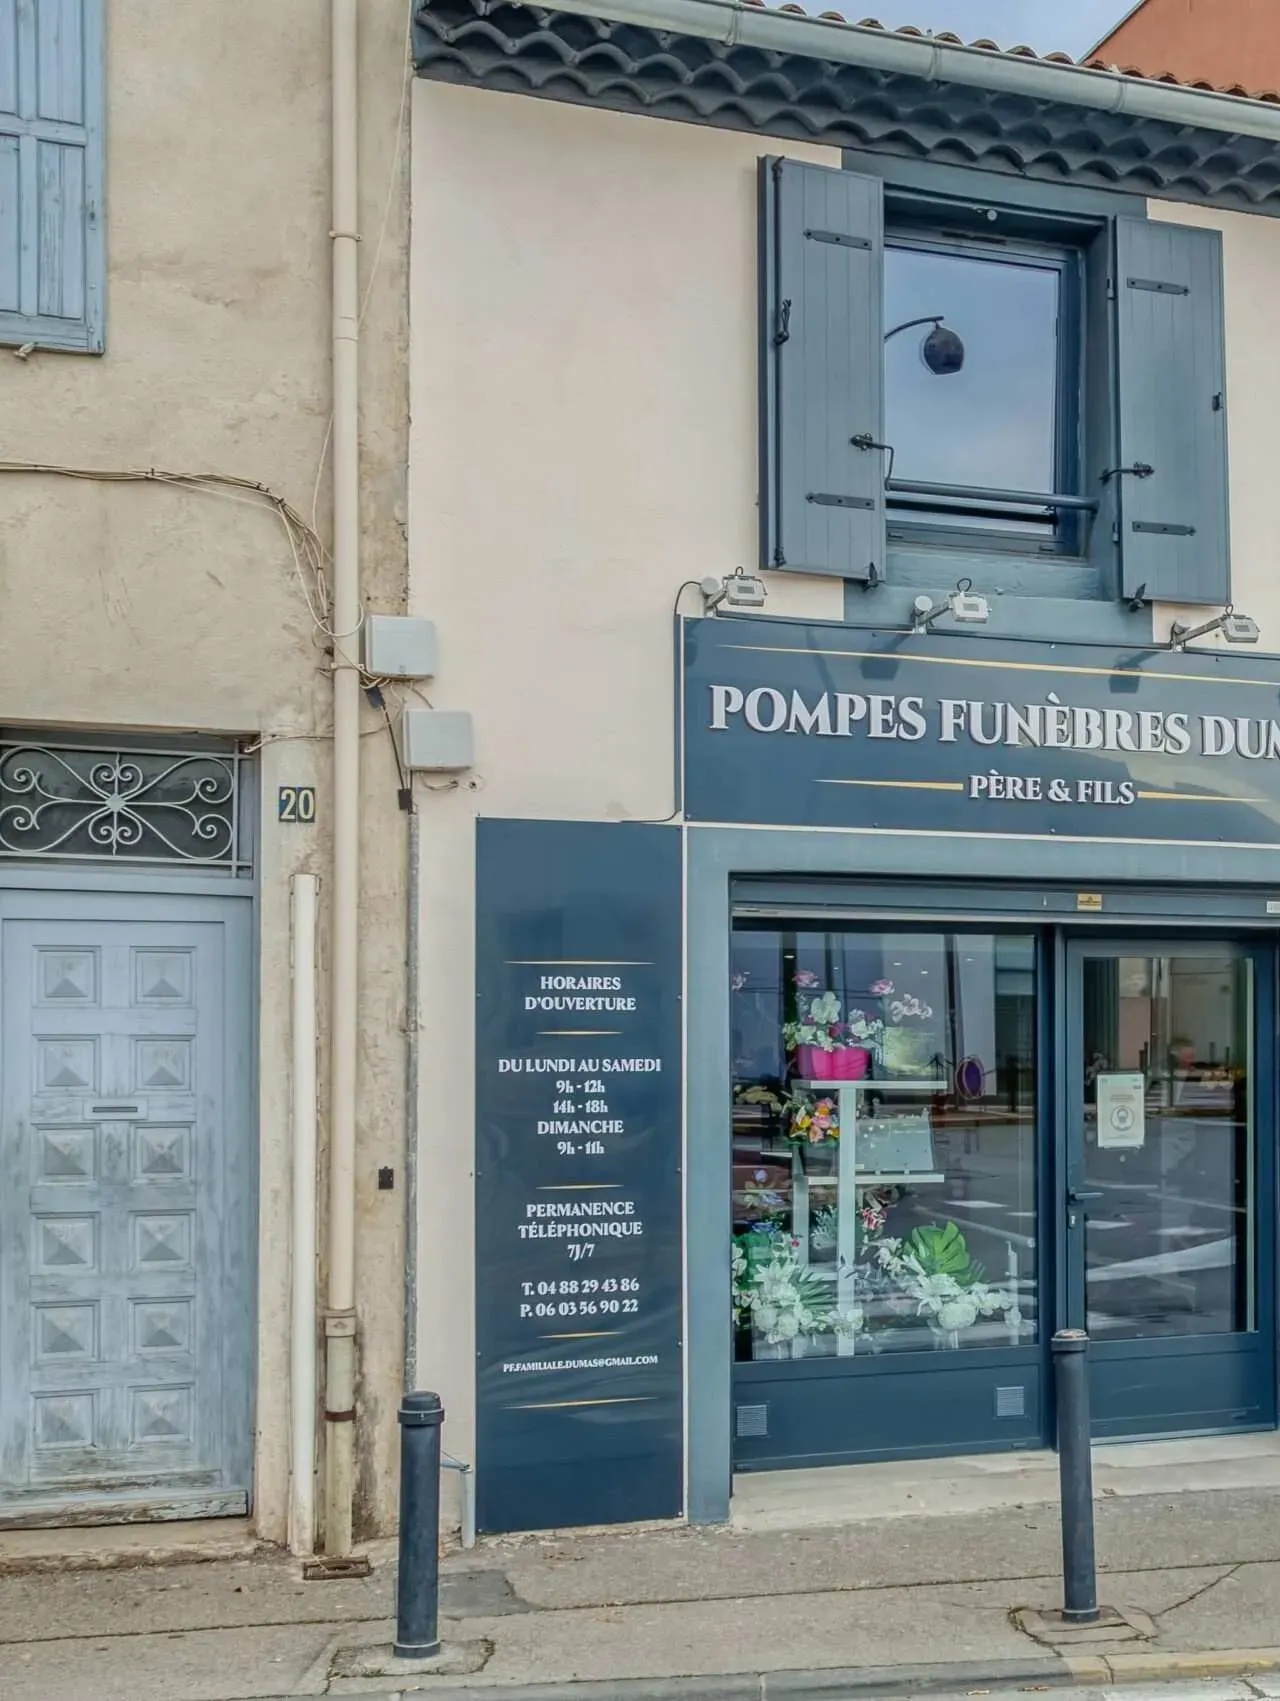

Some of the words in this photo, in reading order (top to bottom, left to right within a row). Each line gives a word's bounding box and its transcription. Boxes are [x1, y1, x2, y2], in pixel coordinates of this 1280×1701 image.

[709, 685, 927, 742] POMPES
[938, 692, 1191, 755] FUNÈBRES
[968, 769, 1042, 801] PÈRE
[1048, 778, 1072, 802] &
[1077, 780, 1135, 805] FILS
[281, 789, 314, 820] 20
[540, 976, 622, 990] HORAIRES
[525, 997, 637, 1011] D'OUVERTURE
[498, 1059, 523, 1073] DU
[525, 1059, 576, 1072] LUNDI
[577, 1059, 600, 1072] AU
[602, 1058, 661, 1072] SAMEDI
[556, 1080, 574, 1093] 9h
[584, 1080, 605, 1093] 12h
[553, 1100, 575, 1113] 14h
[585, 1100, 608, 1113] 18h
[537, 1120, 624, 1134] DIMANCHE
[557, 1141, 575, 1155] 9h
[585, 1141, 605, 1155] 11h
[526, 1202, 635, 1217] PERMANENCE
[518, 1221, 643, 1238] TÉLÉPHONIQUE
[567, 1243, 595, 1261] 7J/7
[521, 1282, 535, 1296] T.
[537, 1281, 557, 1295] 04
[559, 1280, 579, 1294] 88
[581, 1279, 599, 1293] 29
[601, 1279, 618, 1292] 43
[620, 1278, 640, 1291] 86
[520, 1304, 533, 1317] P.
[535, 1303, 556, 1316] 06
[558, 1302, 577, 1316] 03
[579, 1301, 597, 1315] 56
[600, 1300, 619, 1314] 90
[621, 1299, 638, 1313] 22
